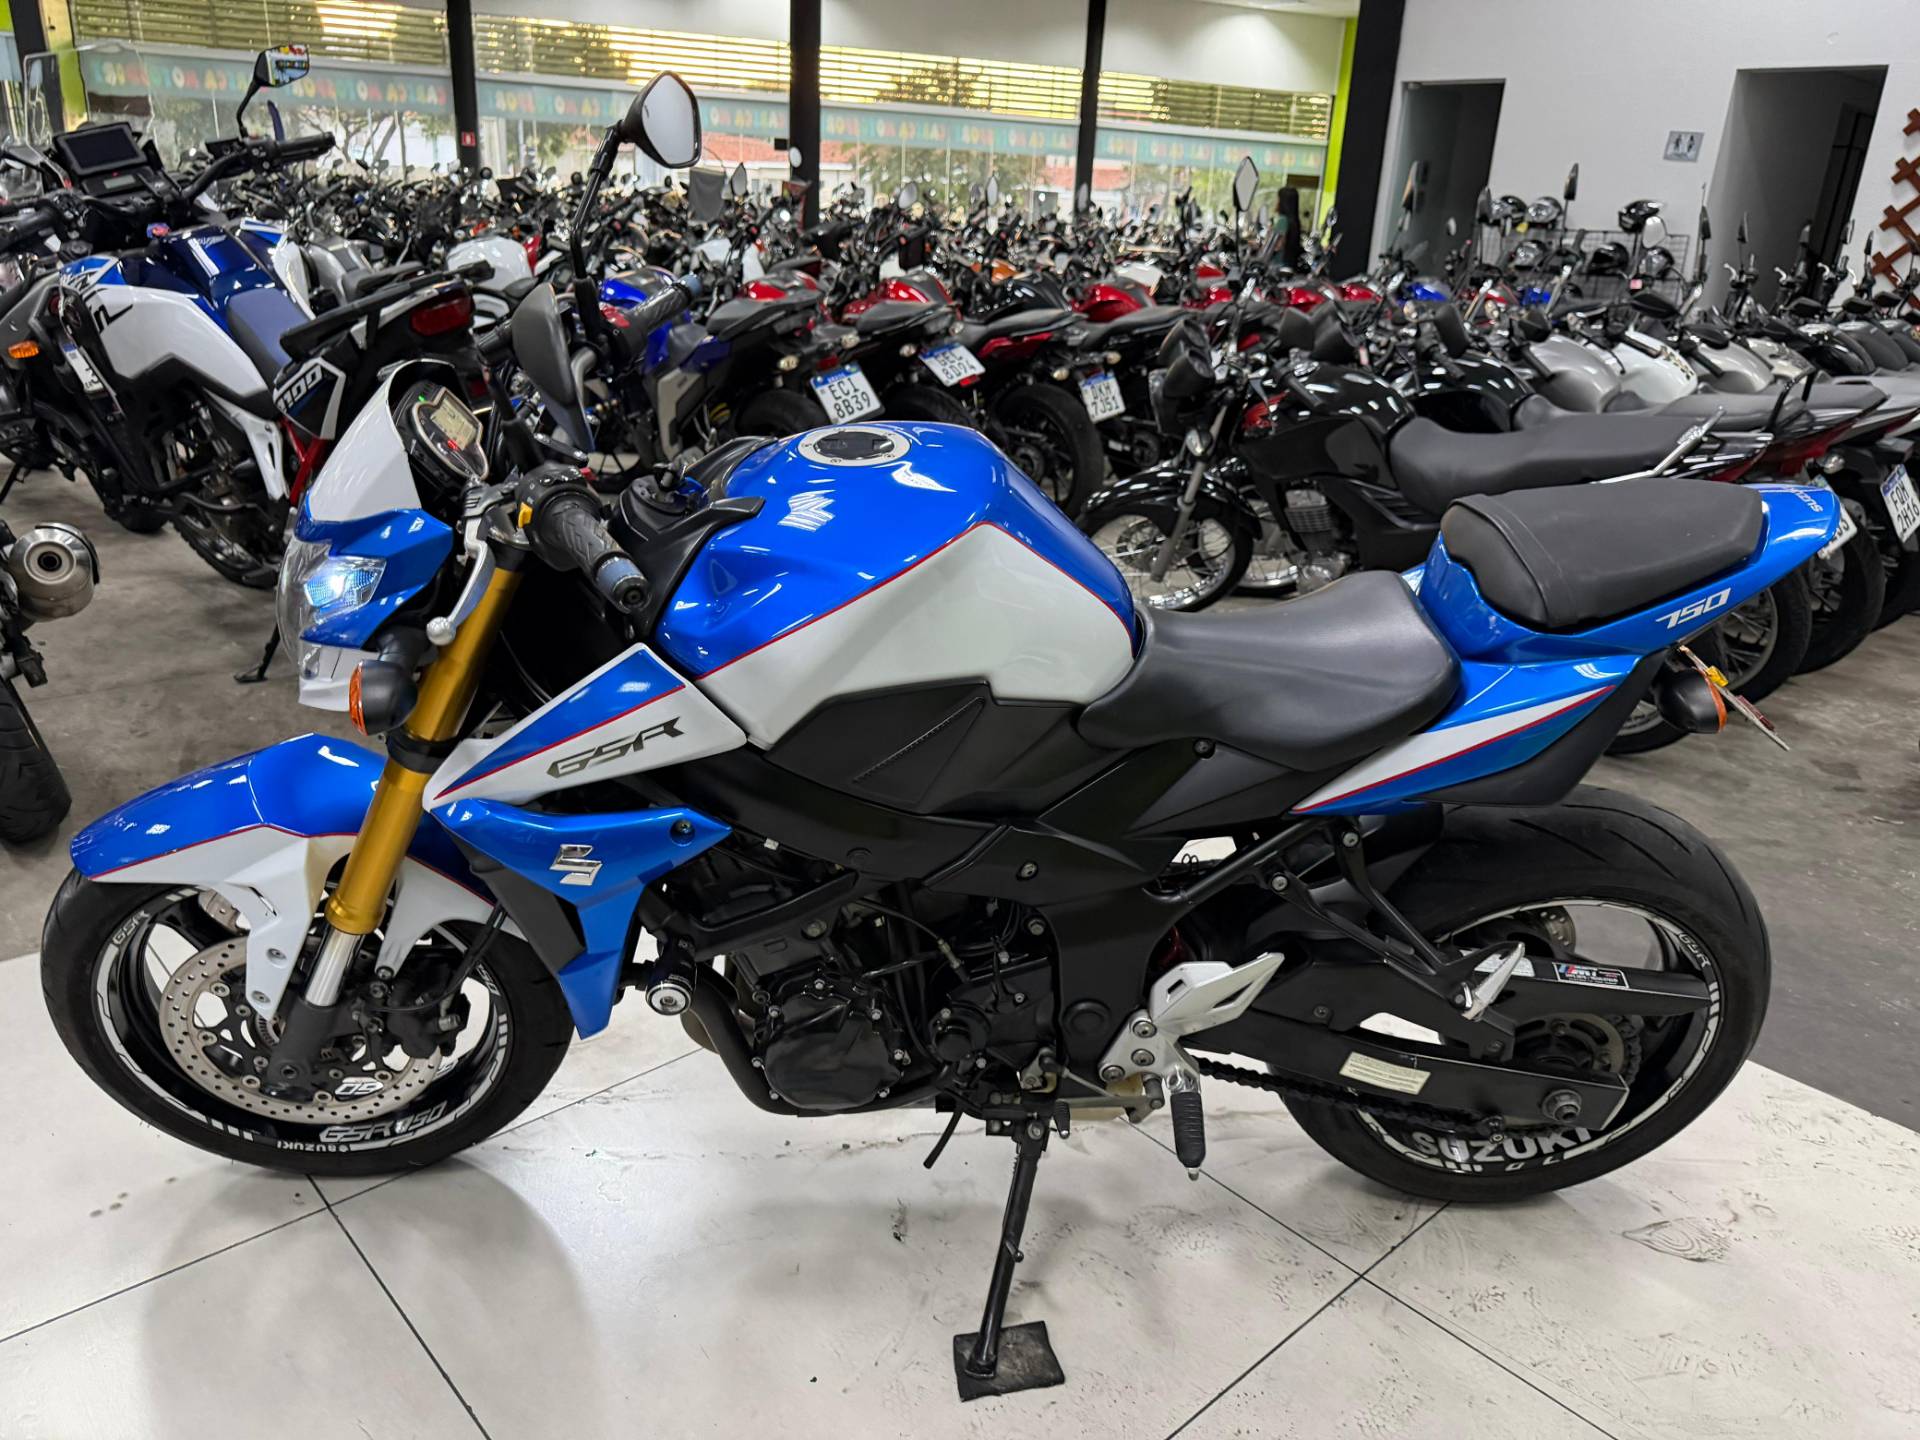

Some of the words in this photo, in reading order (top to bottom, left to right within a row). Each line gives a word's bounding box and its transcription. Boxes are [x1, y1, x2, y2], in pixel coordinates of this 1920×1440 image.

[833, 391, 871, 419] 8B39
[1897, 497, 1920, 534] 2H16
[1656, 587, 1732, 630] 750
[546, 716, 685, 779] GSR
[112, 910, 151, 945] GSR
[1678, 932, 1712, 968] GSR
[276, 1139, 337, 1153] SUZUKI
[319, 1123, 393, 1143] GSR
[1411, 1126, 1592, 1165] SUZUKI
